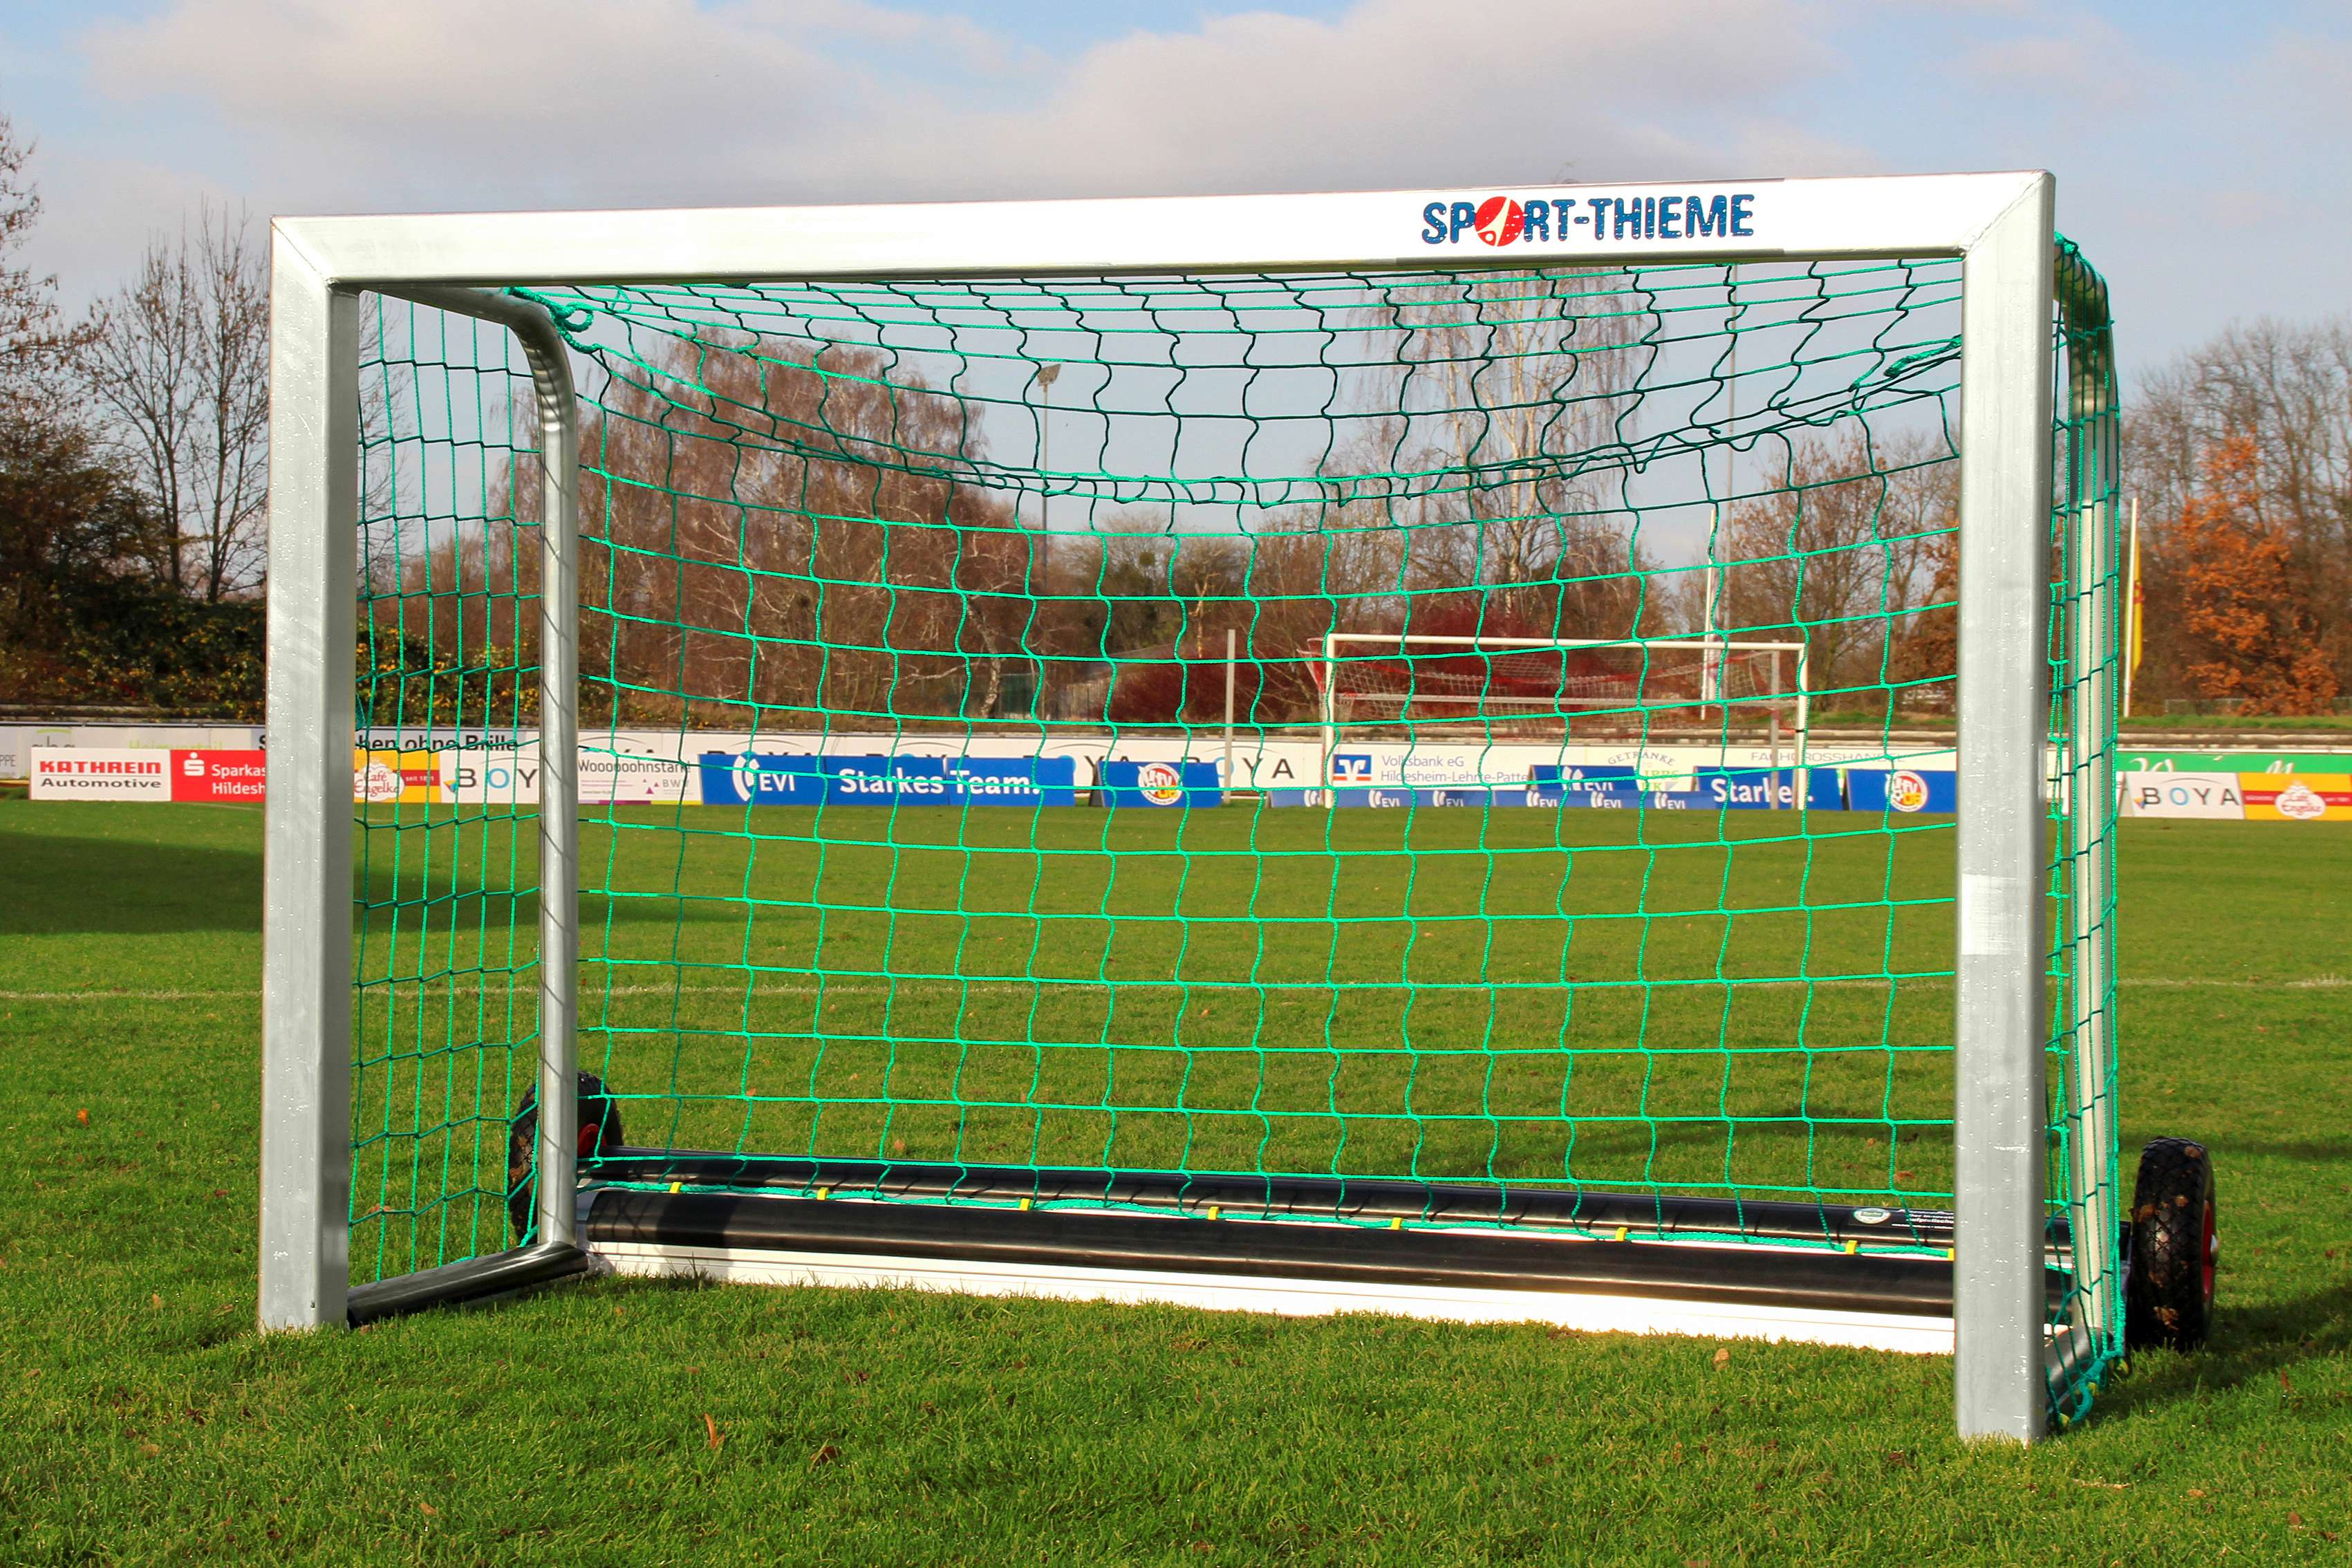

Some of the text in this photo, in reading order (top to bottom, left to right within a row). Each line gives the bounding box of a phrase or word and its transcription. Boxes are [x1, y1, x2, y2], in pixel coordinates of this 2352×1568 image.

[1421, 194, 1755, 248] SPORT-THIEME
[1448, 756, 1464, 767] eG
[39, 761, 161, 774] KATHREIN
[41, 778, 162, 788] Automotive
[759, 772, 795, 792] EVI
[838, 767, 944, 794] Starkes
[2143, 787, 2240, 805] BOYA
[1382, 798, 1401, 808] EVI
[1446, 798, 1464, 807] EVI
[1603, 799, 1622, 808] EVI
[1667, 799, 1686, 809] EVI
